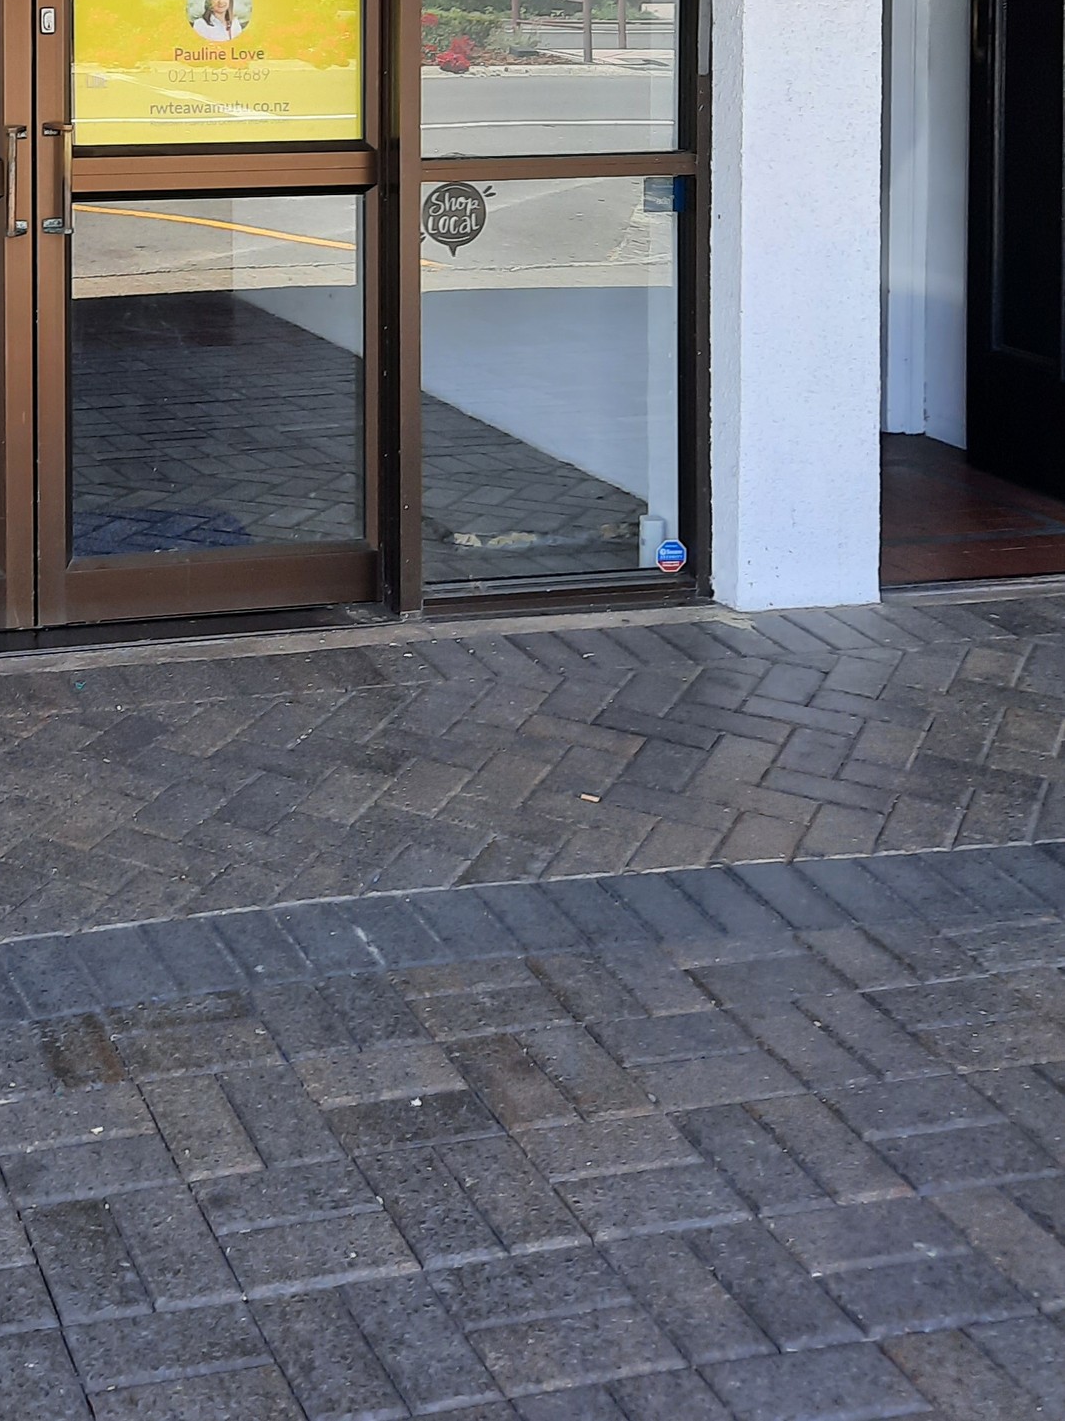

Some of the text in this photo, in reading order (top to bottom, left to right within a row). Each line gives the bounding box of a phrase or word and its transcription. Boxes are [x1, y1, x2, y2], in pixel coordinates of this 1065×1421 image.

[174, 45, 265, 62] Pauline Love
[168, 67, 271, 83] 021 155 4689
[429, 192, 480, 215] Shop
